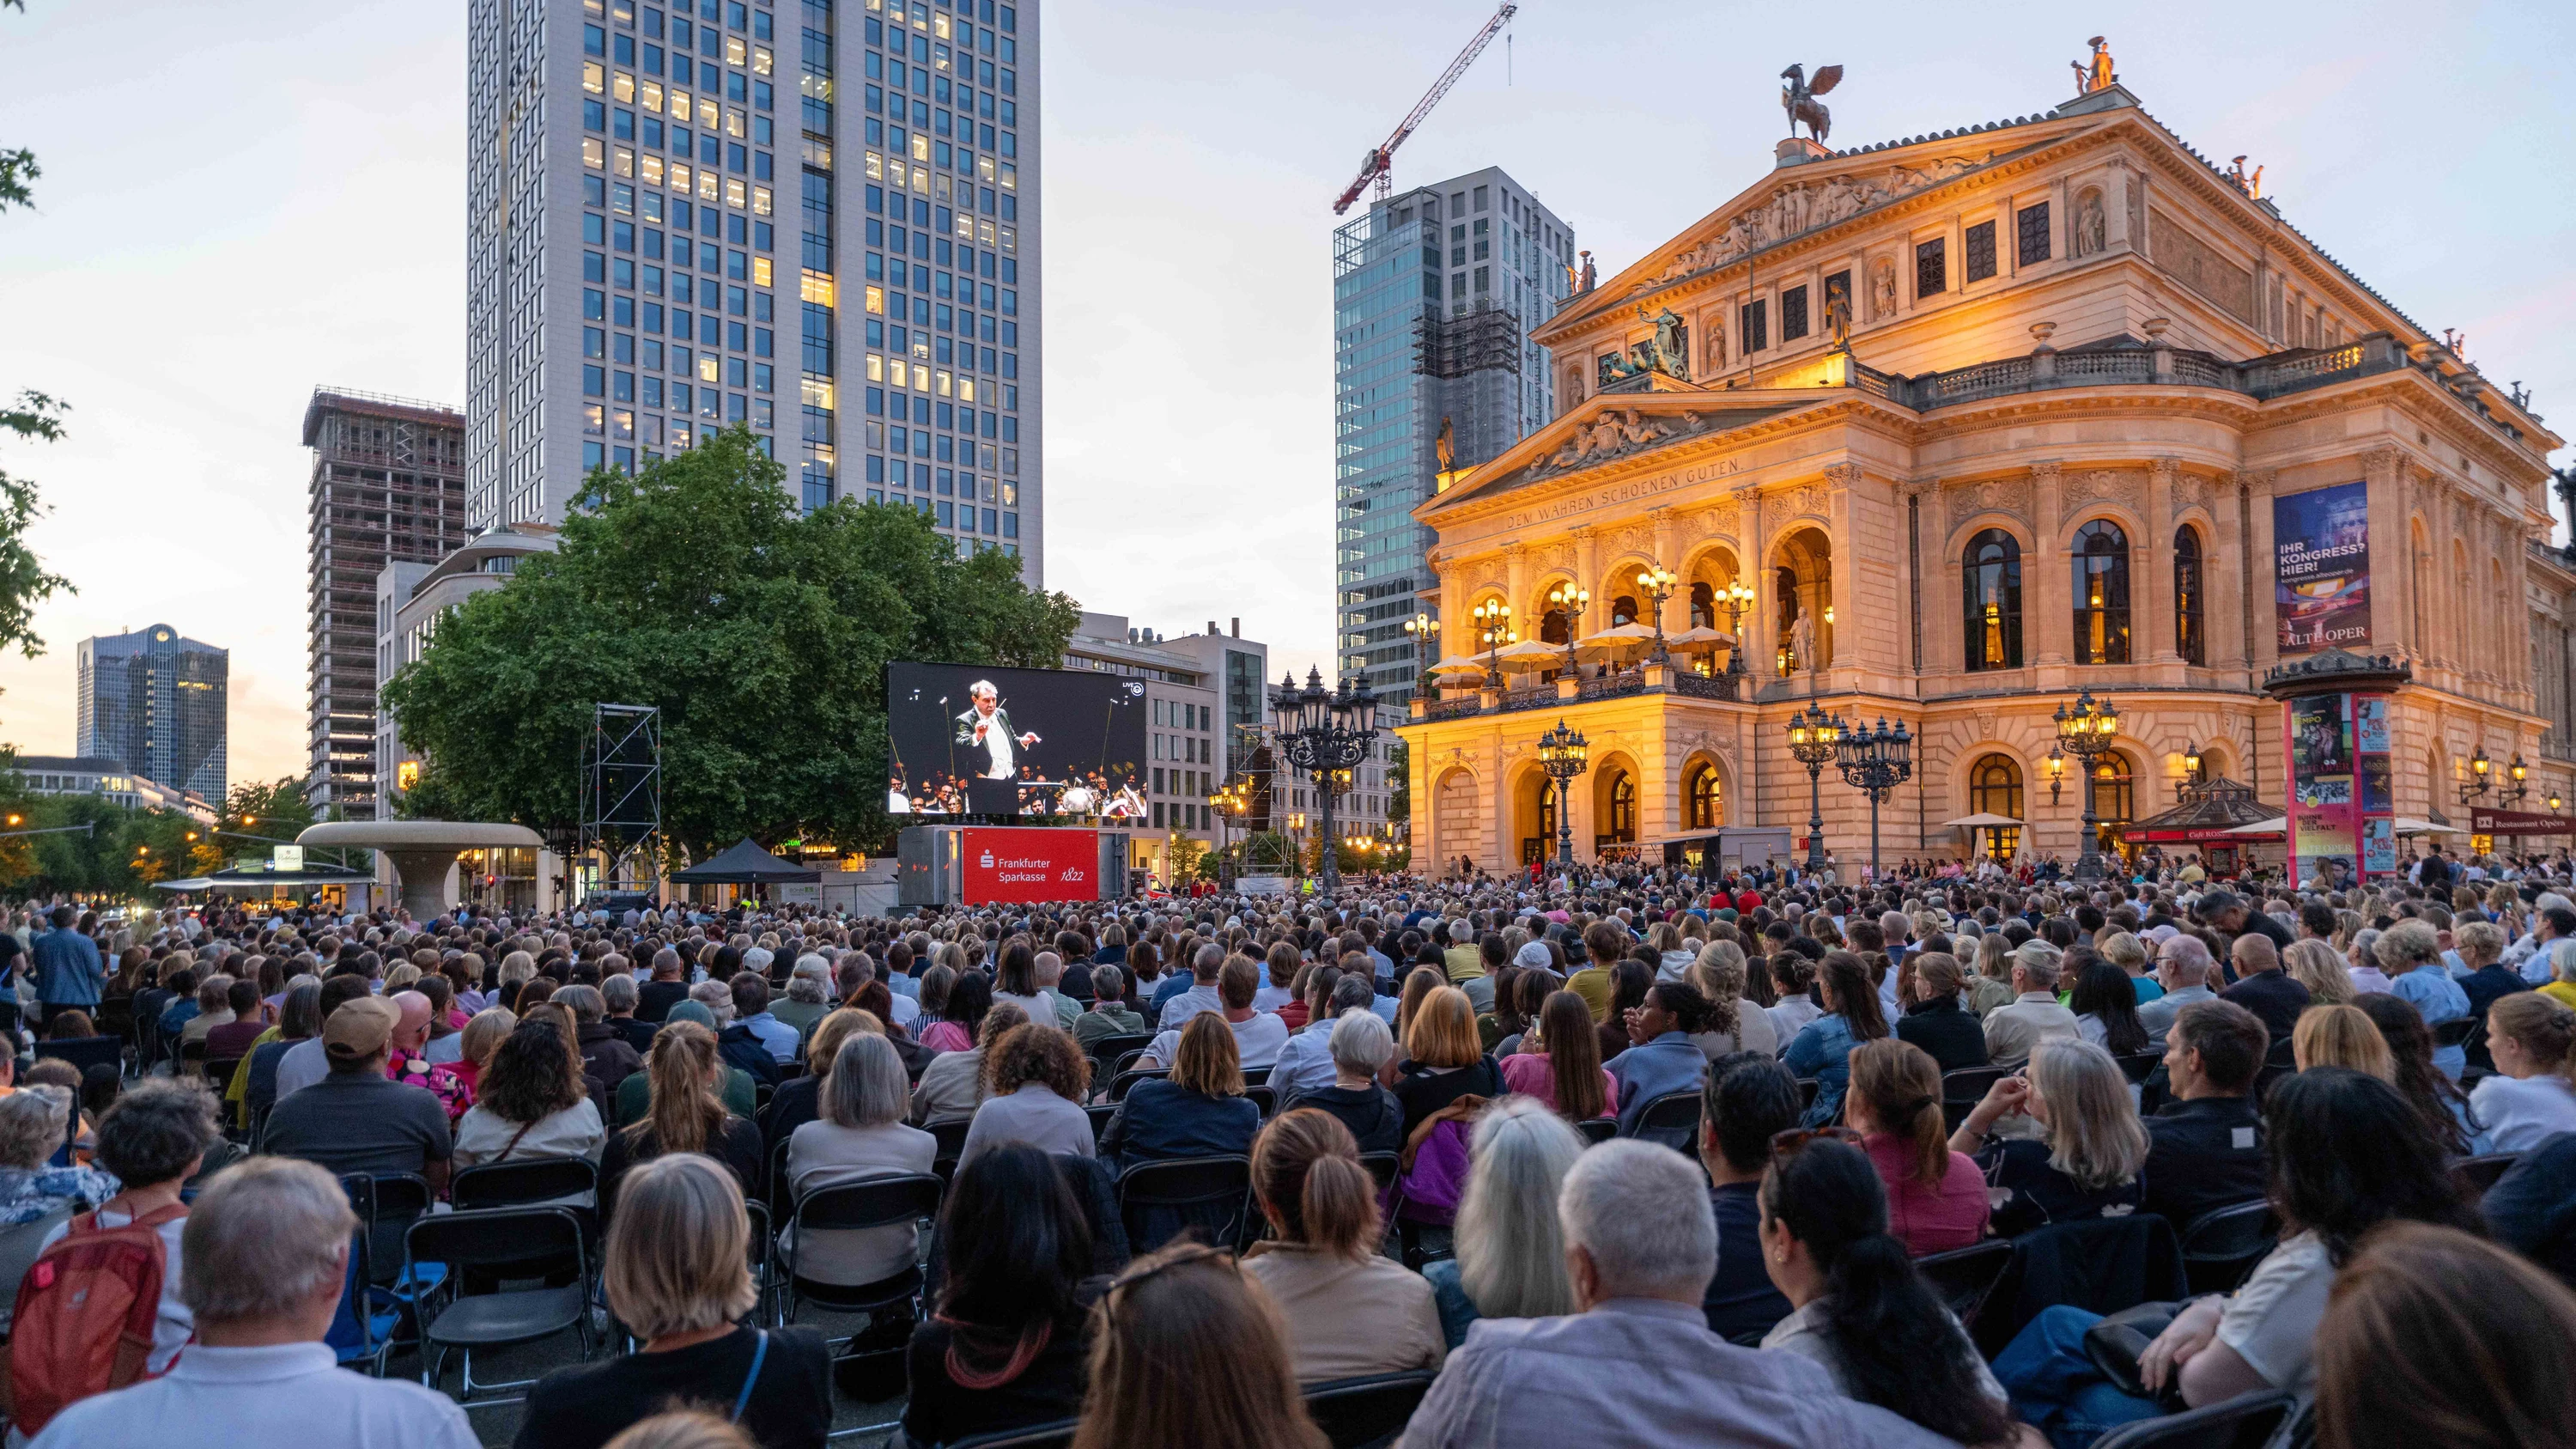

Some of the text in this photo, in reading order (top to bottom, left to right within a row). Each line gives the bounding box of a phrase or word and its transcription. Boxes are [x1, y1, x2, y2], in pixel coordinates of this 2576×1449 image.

[1508, 458, 1744, 528] DEM WAHREN SCHOENEN GUTEN.
[2280, 542, 2304, 554] IHR
[2281, 543, 2366, 565] KONGRESS?
[2281, 562, 2318, 576] HIER!
[2286, 626, 2366, 646] ALTE OPER
[999, 858, 1050, 868] Frankfurter
[999, 867, 1084, 884] Sparkasse 1822
